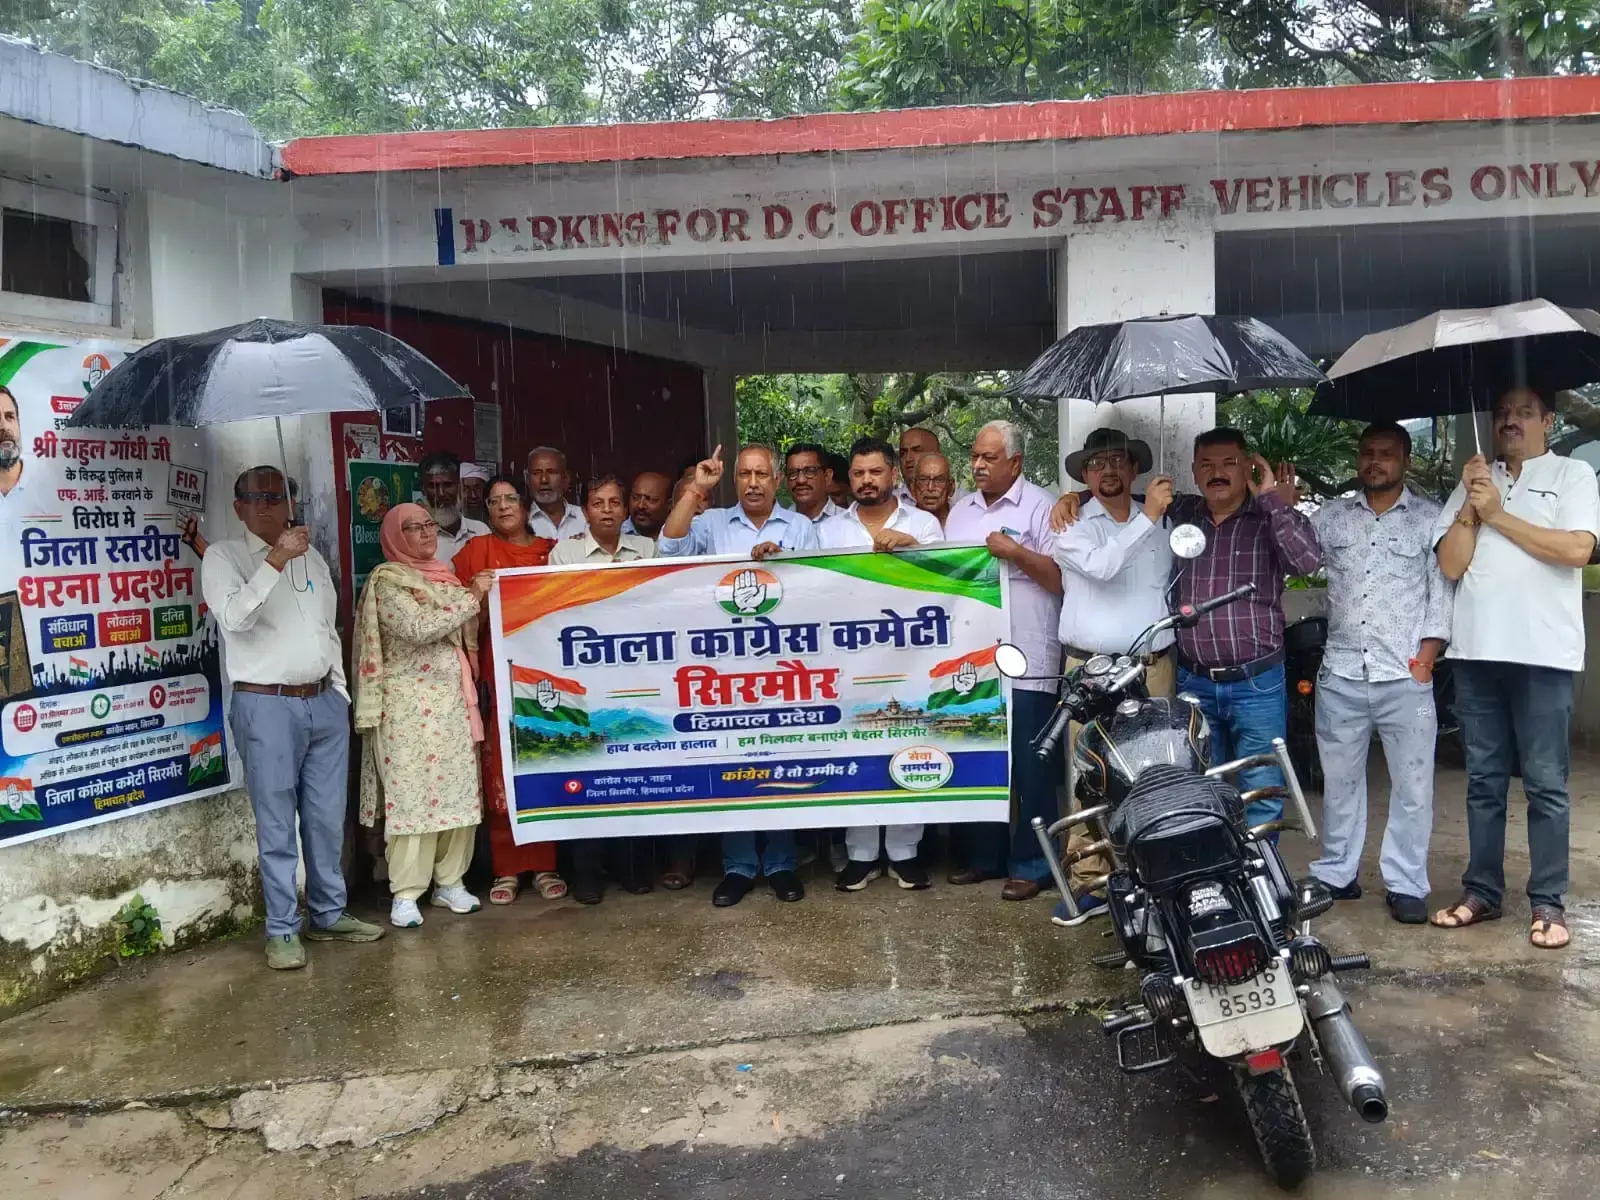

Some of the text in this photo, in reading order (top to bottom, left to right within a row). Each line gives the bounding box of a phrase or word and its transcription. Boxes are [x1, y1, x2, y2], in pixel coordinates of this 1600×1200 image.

[655, 206, 751, 246] FOR
[849, 192, 1012, 237] OFFICE
[1033, 183, 1187, 230] STAFF
[1209, 166, 1454, 215] VEHICLES
[1470, 159, 1600, 202] ONLY
[33, 430, 171, 465] श्री राहुल गाँधी जी
[66, 468, 143, 485] के विरुद्ध पुलिस में
[176, 469, 199, 490] FIR
[57, 485, 153, 502] एफ. आई. करवाने के
[171, 488, 201, 504] वापस लो
[73, 506, 135, 530] विरोध मे
[20, 525, 181, 568] जिला स्तरीय
[17, 558, 194, 608] धरना प्रदर्शन
[106, 612, 142, 628] लोकतंत्र
[162, 607, 185, 622] दलित
[47, 617, 88, 634] संविधान
[160, 620, 188, 636] बचाओ
[53, 632, 87, 649] बचाओ
[110, 628, 141, 642] बचाओ
[557, 605, 951, 667] जिला कांग्रेस कमेटी
[672, 659, 840, 708] सिरमौर
[689, 708, 825, 731] हिमाचल प्रदेश
[606, 737, 717, 754] हाथ बदलेगा हालात
[737, 735, 756, 749] हम
[760, 732, 804, 746] मिलकर
[807, 728, 848, 743] बनाएंगे
[852, 727, 884, 740] बेहतर
[908, 750, 932, 761] सेवा
[721, 761, 859, 782] कांग्रेस है तो उम्मीद है
[900, 761, 942, 773] समर्पण
[45, 760, 183, 807] जिला कांग्रेस कमेटी सिरमौर
[593, 774, 621, 786] कांग्रेस
[649, 774, 672, 783] नाहन
[903, 771, 941, 784] संगठन
[586, 787, 607, 799] जिला
[640, 784, 674, 796] हिमाचल
[675, 783, 695, 795] प्रदेश
[94, 794, 126, 810] हिमाचल
[1219, 987, 1277, 1017] 8593
